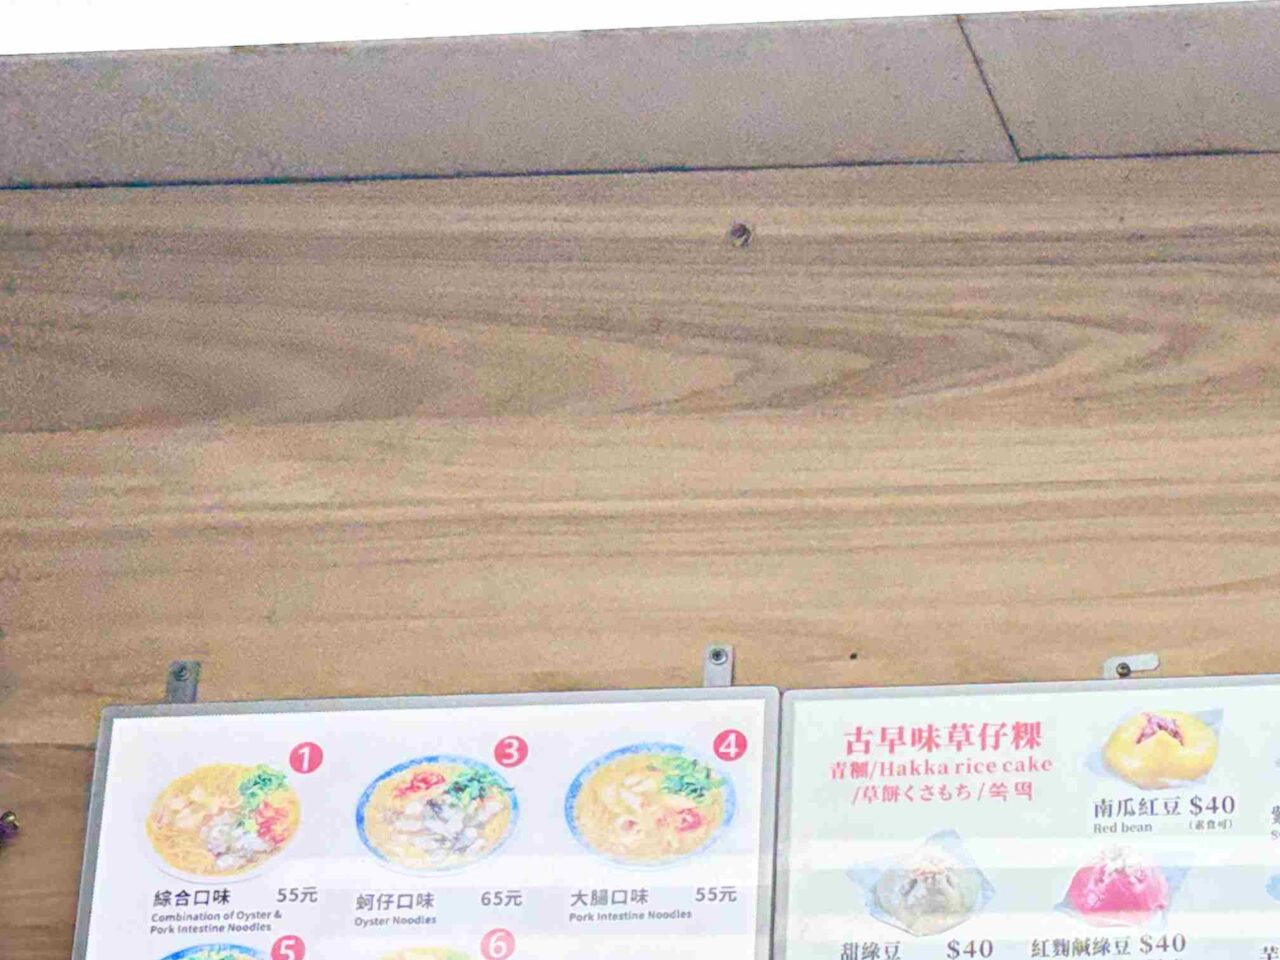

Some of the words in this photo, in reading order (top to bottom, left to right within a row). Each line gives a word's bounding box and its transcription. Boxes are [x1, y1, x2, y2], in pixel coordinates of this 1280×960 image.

[719, 733, 740, 758] 4
[844, 721, 1043, 756] 古早味草仔粿
[299, 747, 310, 771] 1
[501, 739, 521, 764] 3
[955, 757, 997, 775] rice
[1002, 756, 1053, 773] cake
[1094, 798, 1181, 818] 南瓜紅豆
[1190, 795, 1235, 817] $40
[1094, 823, 1117, 834] Red
[1121, 821, 1153, 833] bean
[153, 889, 231, 907] 綜合口味
[277, 887, 318, 904] 55元
[355, 892, 435, 911] 蚵仔口味
[481, 890, 523, 907] 65元
[570, 889, 649, 906] 大腸口味
[695, 886, 737, 903] 55元
[151, 911, 220, 922] Combination
[224, 911, 235, 921] of
[237, 910, 271, 923] Oyster
[274, 911, 282, 920] &
[354, 917, 389, 928] Oyster
[394, 915, 437, 926] Noodles
[569, 912, 594, 922] Pork
[597, 911, 645, 921] Intestine
[648, 909, 692, 920] Noodles
[150, 924, 175, 935] Pork
[178, 923, 225, 933] Intestine
[228, 922, 272, 932] Noodles
[489, 933, 506, 957] 6
[947, 939, 993, 959] $40
[1139, 933, 1186, 955] $40
